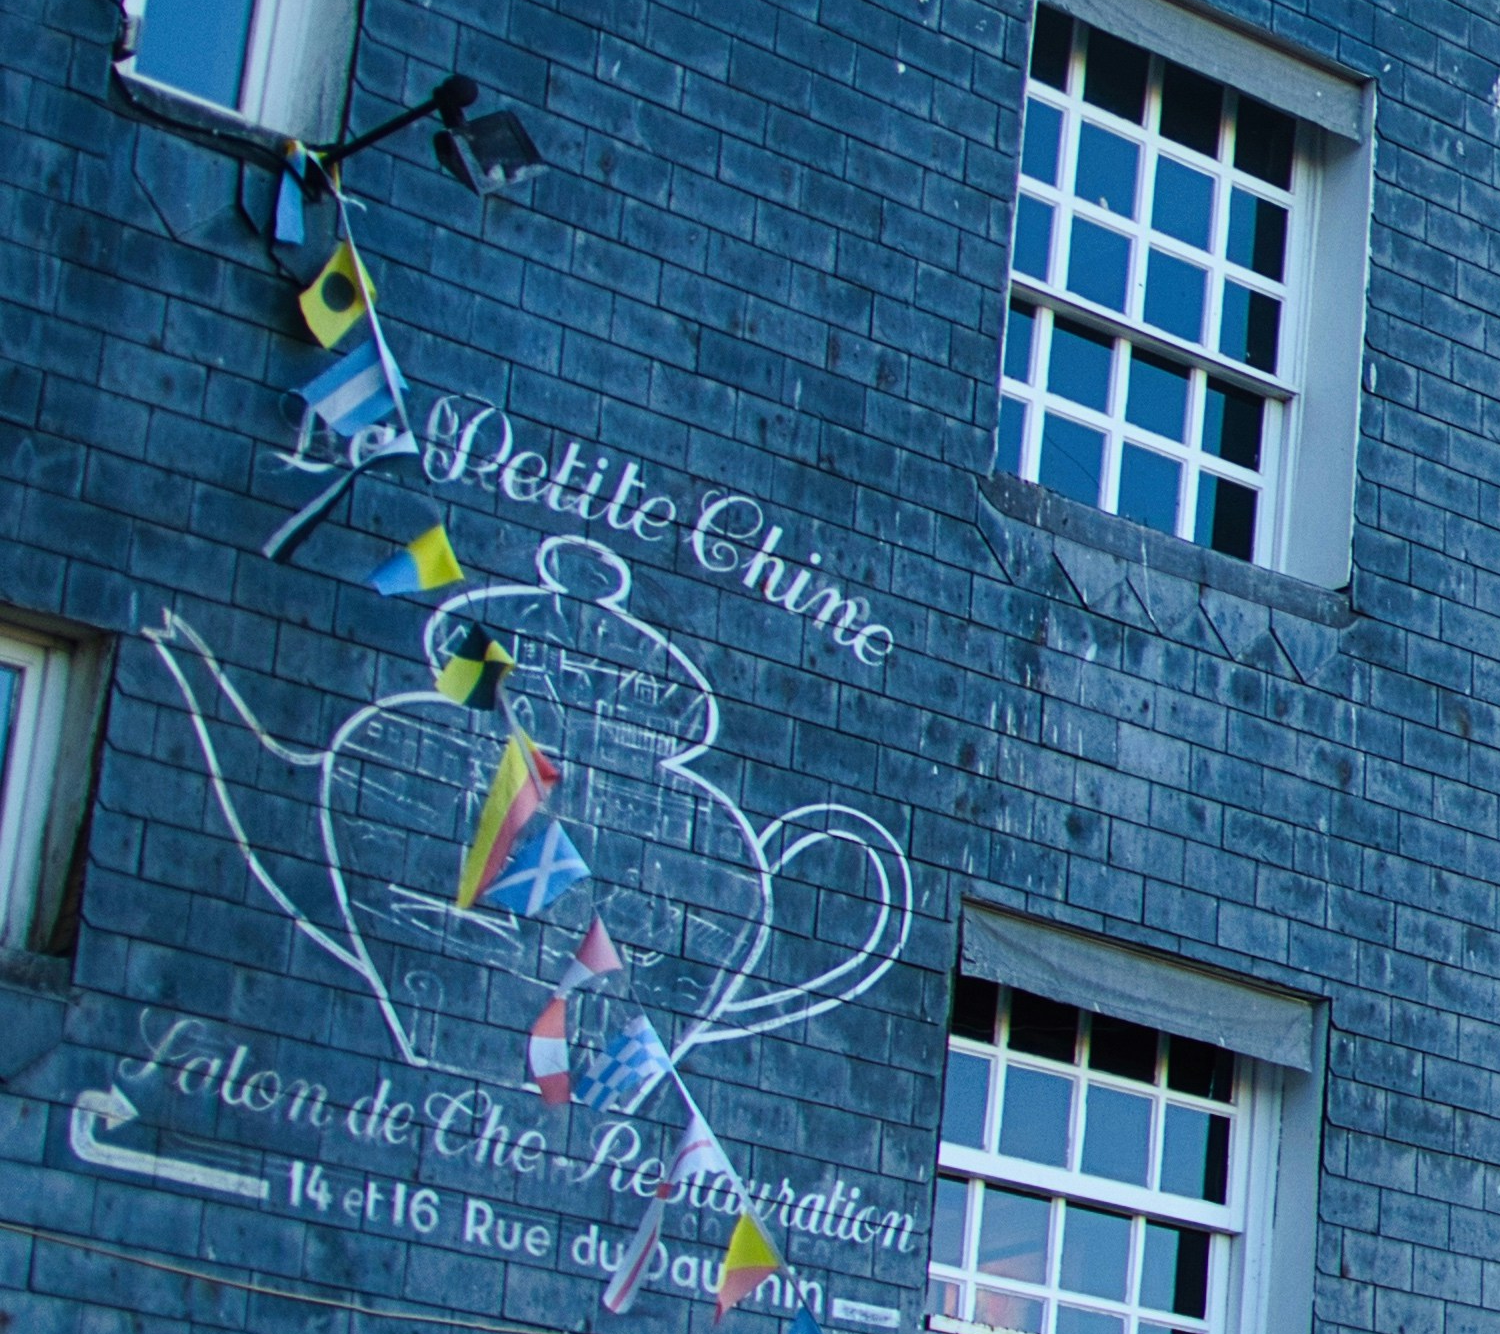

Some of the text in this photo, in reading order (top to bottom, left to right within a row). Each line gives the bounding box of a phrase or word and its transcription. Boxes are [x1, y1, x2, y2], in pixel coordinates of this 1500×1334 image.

[423, 393, 677, 542] Petite
[690, 488, 895, 667] Chine
[118, 1008, 331, 1126] Salon
[347, 1079, 415, 1144] de
[289, 1161, 331, 1210] 14
[392, 1183, 440, 1234] 16
[464, 1198, 551, 1258] Rue
[571, 1223, 626, 1272] du
